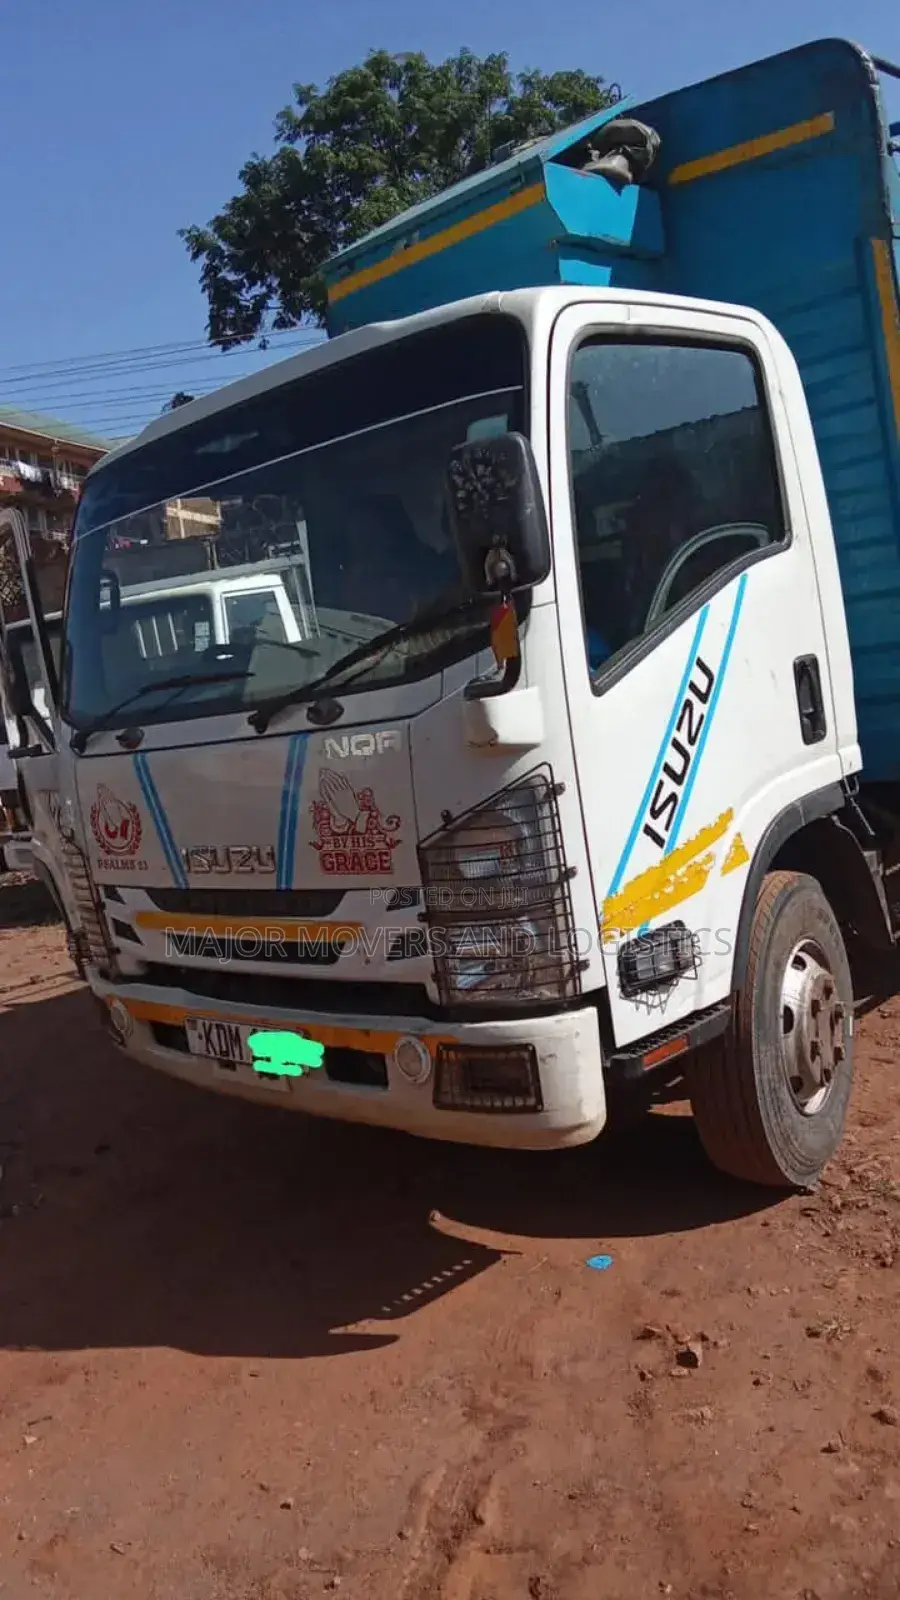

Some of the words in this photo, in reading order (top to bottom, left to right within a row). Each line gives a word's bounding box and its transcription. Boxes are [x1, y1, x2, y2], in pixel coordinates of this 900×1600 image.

[643, 657, 715, 849] ISUZU
[333, 835, 348, 849] BY
[352, 834, 376, 849] HIS
[181, 844, 276, 874] ISUZU
[321, 850, 393, 873] GRACE
[202, 1022, 244, 1061] KDM
